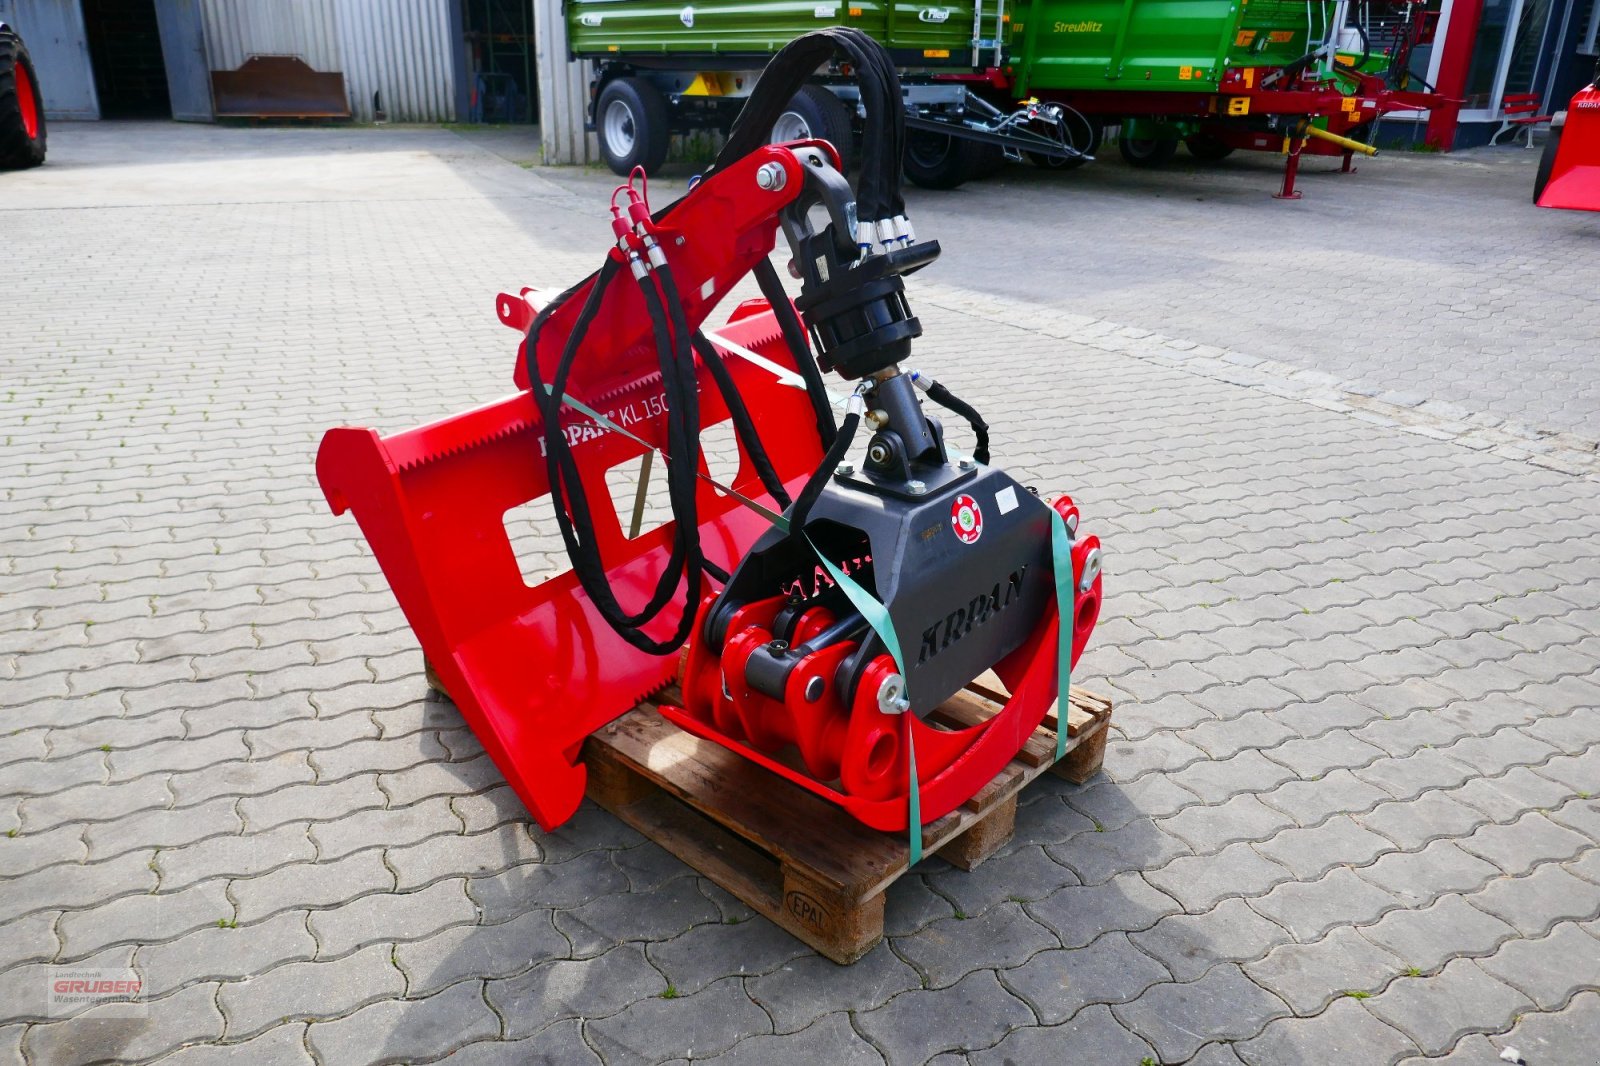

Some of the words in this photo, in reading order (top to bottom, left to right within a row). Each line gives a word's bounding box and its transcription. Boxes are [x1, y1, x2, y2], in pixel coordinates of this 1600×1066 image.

[1054, 21, 1103, 33] Streublitz
[619, 404, 643, 427] KL
[915, 564, 1028, 667] KRPAN
[793, 896, 825, 929] EPAL
